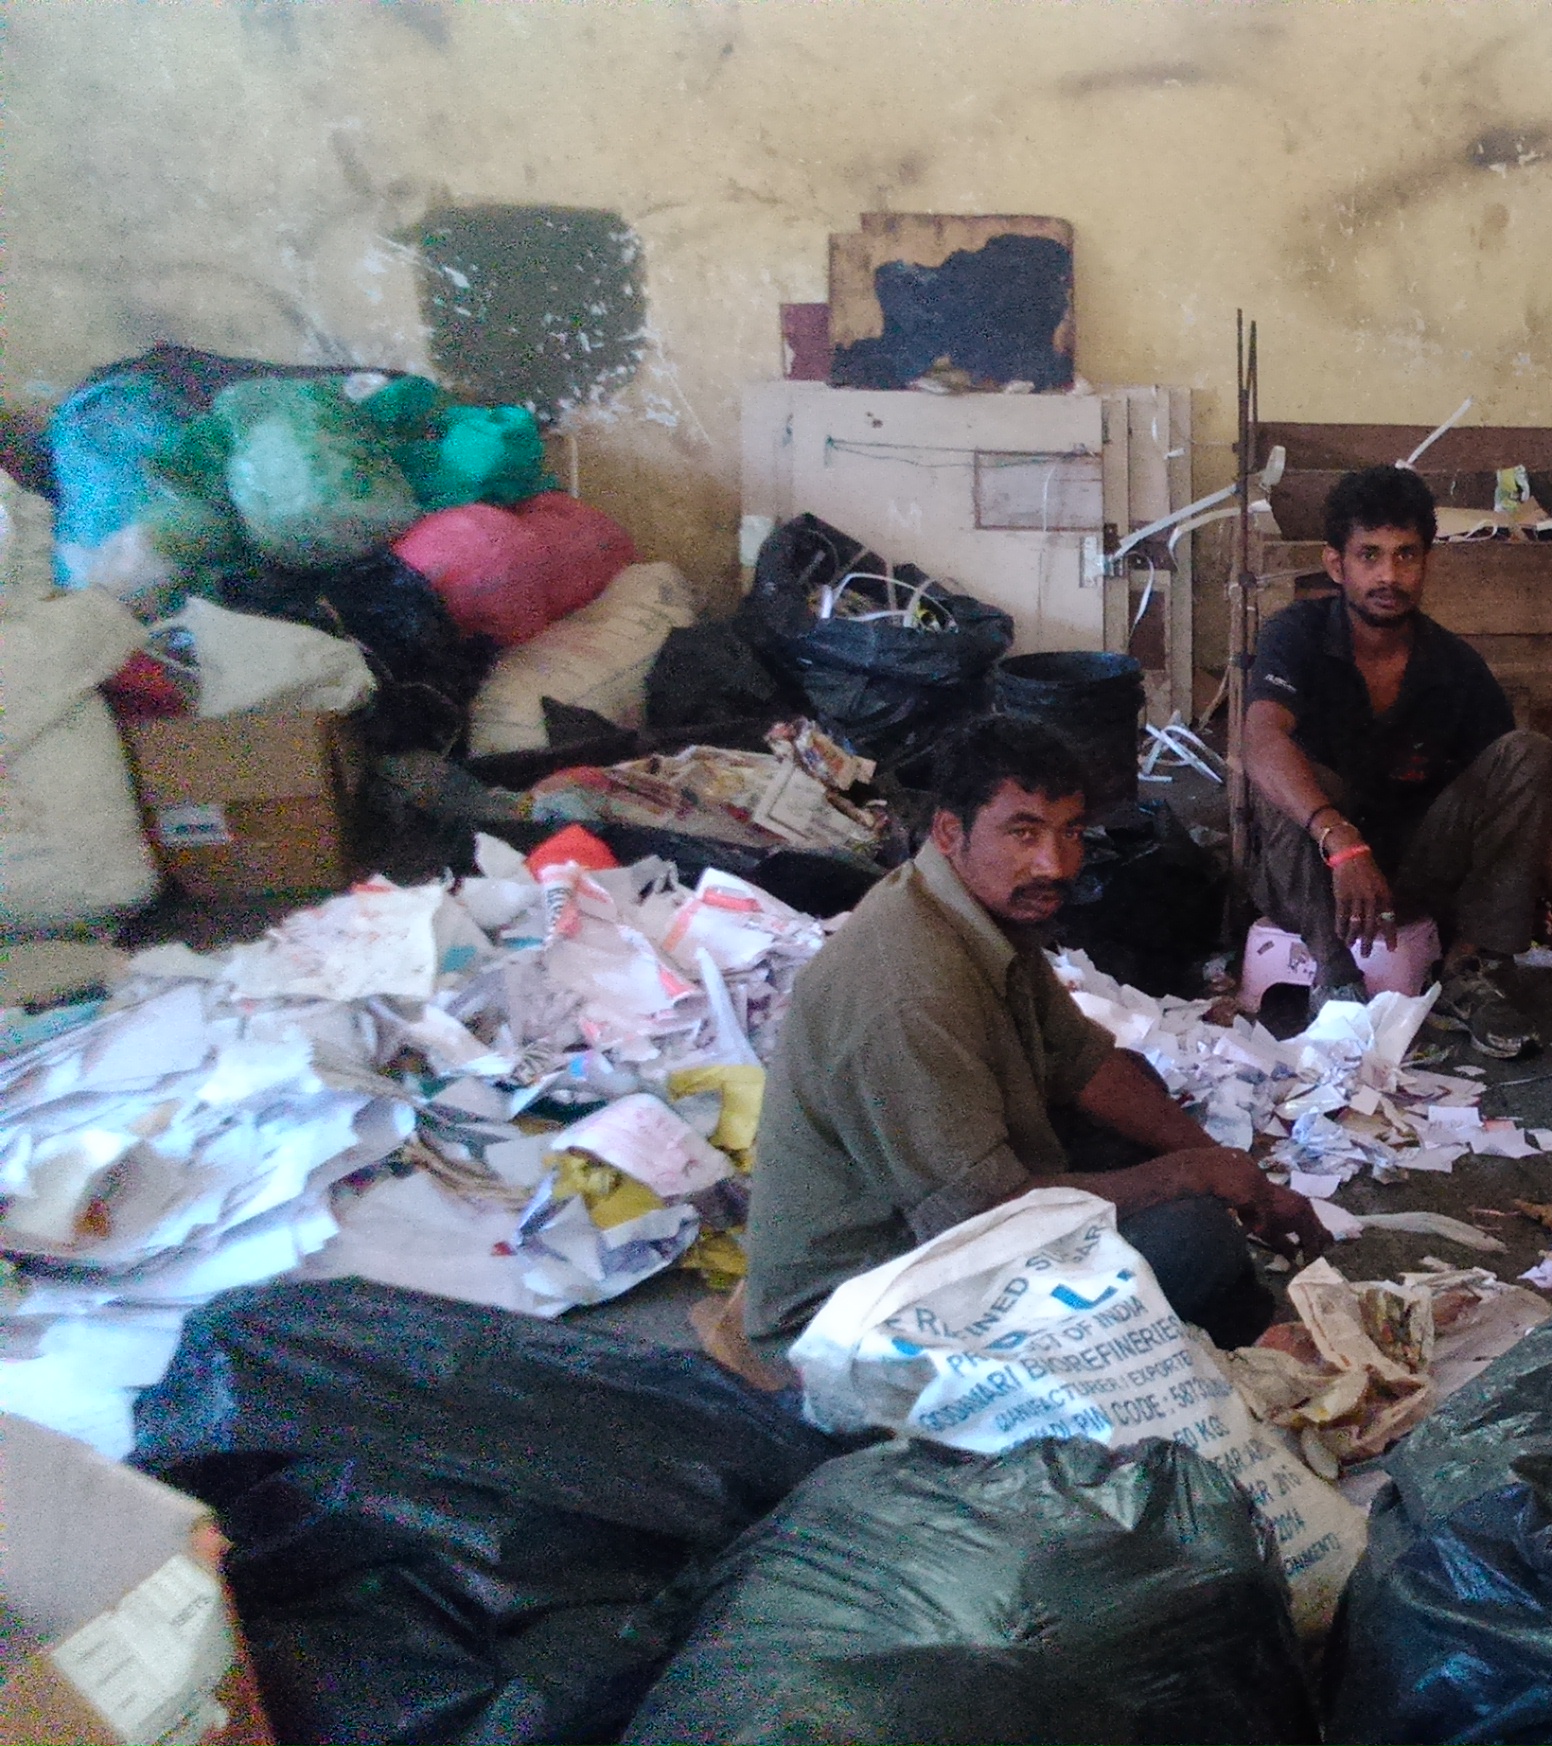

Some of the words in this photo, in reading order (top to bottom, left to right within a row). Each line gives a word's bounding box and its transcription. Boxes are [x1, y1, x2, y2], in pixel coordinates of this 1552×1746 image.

[1025, 1224, 1103, 1272] SAR
[1063, 1319, 1093, 1342] OF
[1092, 1294, 1149, 1330] INDIA
[1019, 1314, 1183, 1382] BIOREFINERIES
[1071, 1405, 1114, 1434] PIN
[1110, 1392, 1166, 1427] CODE
